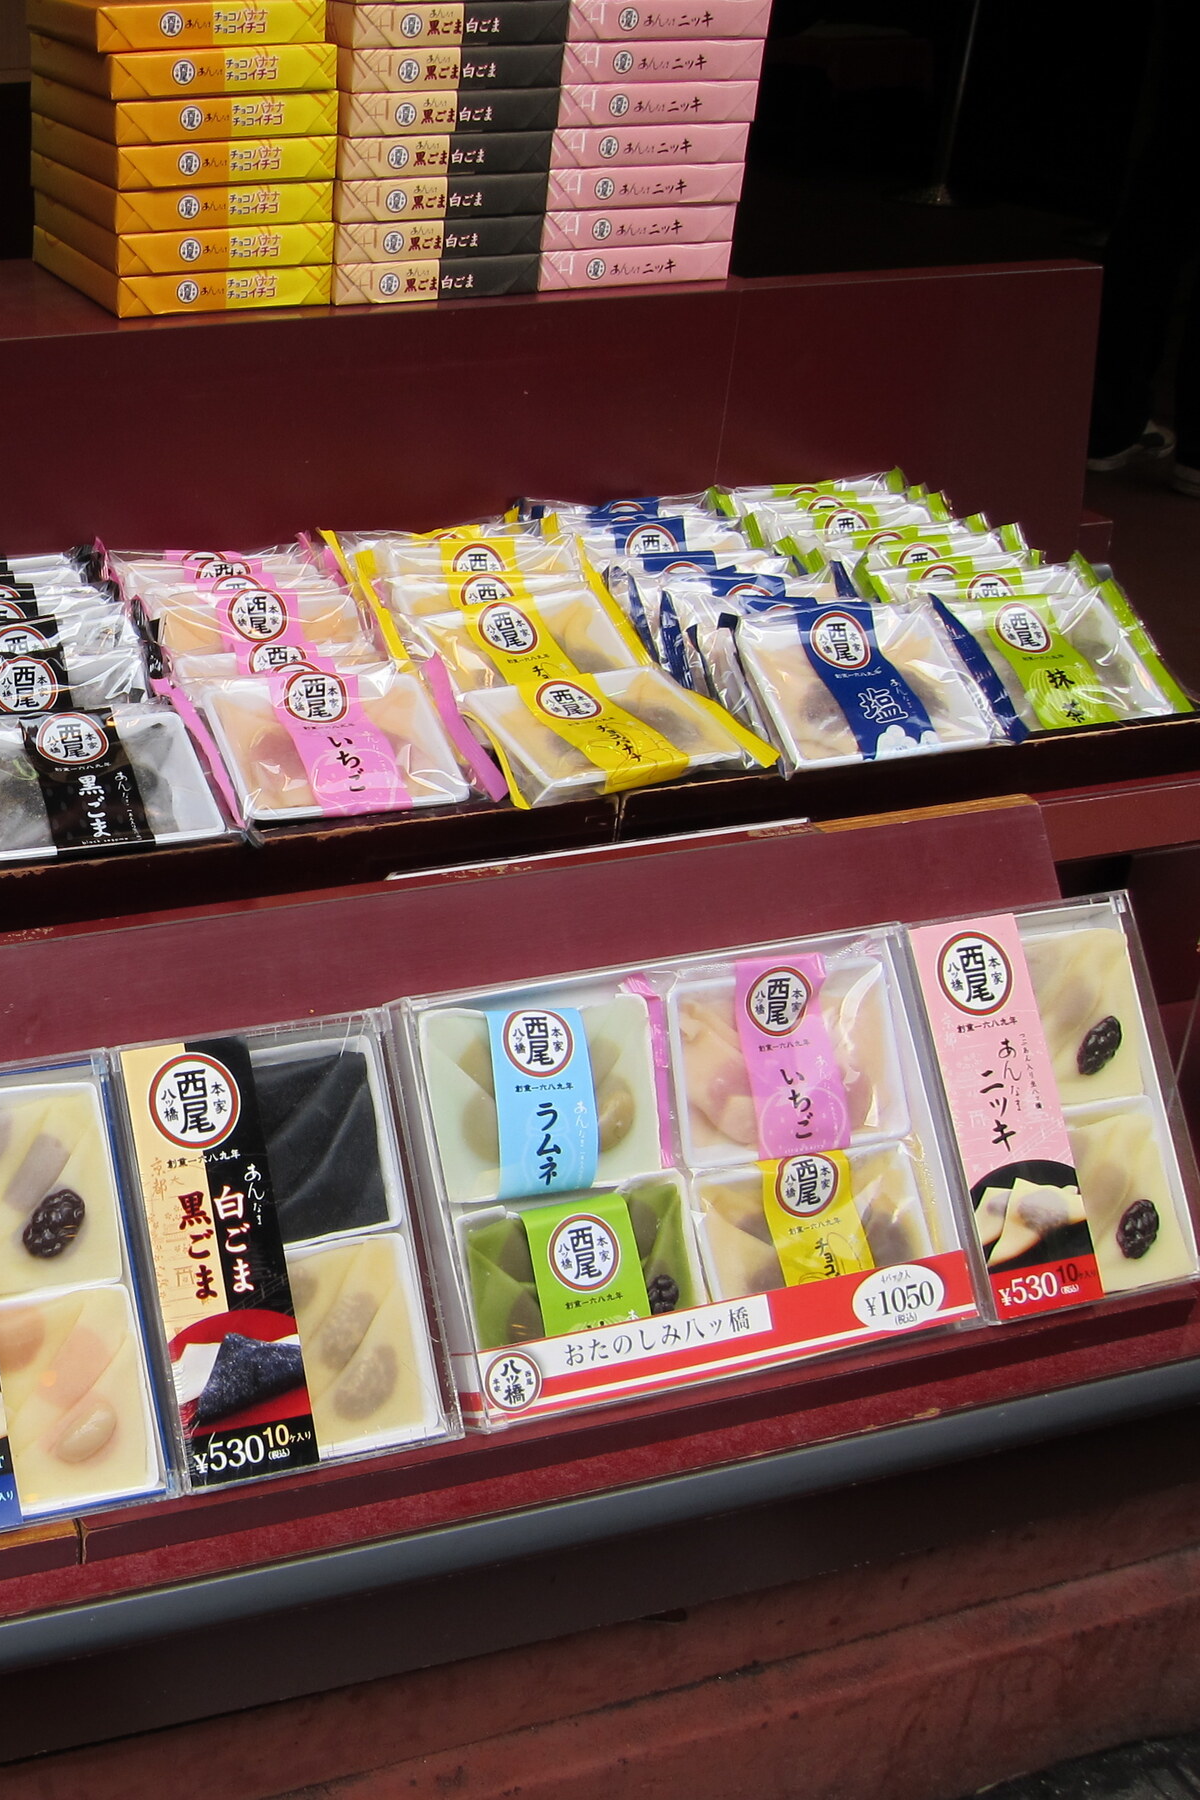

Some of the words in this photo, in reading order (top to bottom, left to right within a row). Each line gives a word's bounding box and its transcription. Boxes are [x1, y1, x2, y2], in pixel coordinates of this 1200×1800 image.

[214, 10, 268, 22] チョコバナナ
[678, 10, 714, 27] ニッキ
[214, 22, 266, 34] チョコイチゴ
[427, 19, 462, 36] 黒ごま
[466, 18, 501, 34] 白ごま
[226, 56, 279, 68] チョコバナナ
[462, 62, 497, 78] 白ごま
[672, 54, 707, 70] ニッキ
[226, 69, 277, 82] チョコイチゴ
[424, 64, 459, 81] 黒ごま
[233, 102, 285, 115] チョコバナナ
[667, 96, 702, 112] ニッキ
[233, 114, 283, 127] チョコイチゴ
[421, 108, 456, 125] 黒ごま
[459, 107, 493, 122] 白ごま
[230, 147, 282, 160] チョコバナナ
[658, 139, 692, 154] ニッキ
[414, 151, 448, 167] 黒ごま
[452, 149, 485, 165] 白ごま
[230, 160, 280, 172] チョコイチゴ
[652, 179, 688, 195] ニッキ
[229, 191, 281, 204] チョコバナナ
[411, 194, 446, 210] 黒ごま
[450, 192, 483, 208] 白ごま
[229, 203, 279, 216] チョコイチゴ
[649, 219, 684, 235] ニッキ
[230, 234, 281, 247] チョコバナナ
[408, 235, 443, 252] 黒ごま
[446, 233, 479, 249] 白ごま
[230, 246, 280, 258] チョコイチゴ
[642, 259, 676, 275] ニッキ
[227, 276, 279, 288] チョコバナナ
[405, 276, 440, 292] 黒ごま
[442, 274, 474, 290] 白ごま
[227, 286, 276, 300] チョコイチゴ
[245, 595, 272, 635] 西尾
[492, 611, 527, 649] 西尾
[1008, 611, 1041, 650] 西尾
[826, 621, 857, 662] 西尾
[11, 665, 40, 708] 西尾
[302, 677, 333, 719] 西尾
[554, 688, 590, 717] 西尾
[858, 687, 909, 724] 塩
[56, 722, 91, 758] 西尾
[327, 736, 367, 792] いちご
[78, 774, 112, 838] 黒ごま
[956, 943, 995, 1003] 西尾
[987, 956, 1004, 986] 本家
[765, 977, 791, 1026] 西尾
[957, 1015, 1018, 1034] 創業一六八九年
[521, 1015, 555, 1066] 西尾
[515, 1082, 574, 1093] 創業一六八九年
[173, 1068, 217, 1135] 西尾
[211, 1081, 228, 1115] 本家
[779, 1067, 814, 1140] いちご
[979, 1068, 1017, 1153] ニッキ
[536, 1101, 562, 1186] ラムネ
[166, 1149, 241, 1170] 創業一六八九年
[791, 1158, 822, 1207] 西尾
[243, 1163, 266, 1226] あんなま
[176, 1190, 219, 1301] 黒ごま
[212, 1184, 255, 1294] 白ごま
[567, 1225, 603, 1280] 西尾
[596, 1235, 611, 1262] 本家
[998, 1271, 1059, 1307] ¥530
[565, 1291, 624, 1311] 創業一六八九年
[865, 1280, 935, 1317] ¥1050
[193, 1434, 265, 1475] ¥530
